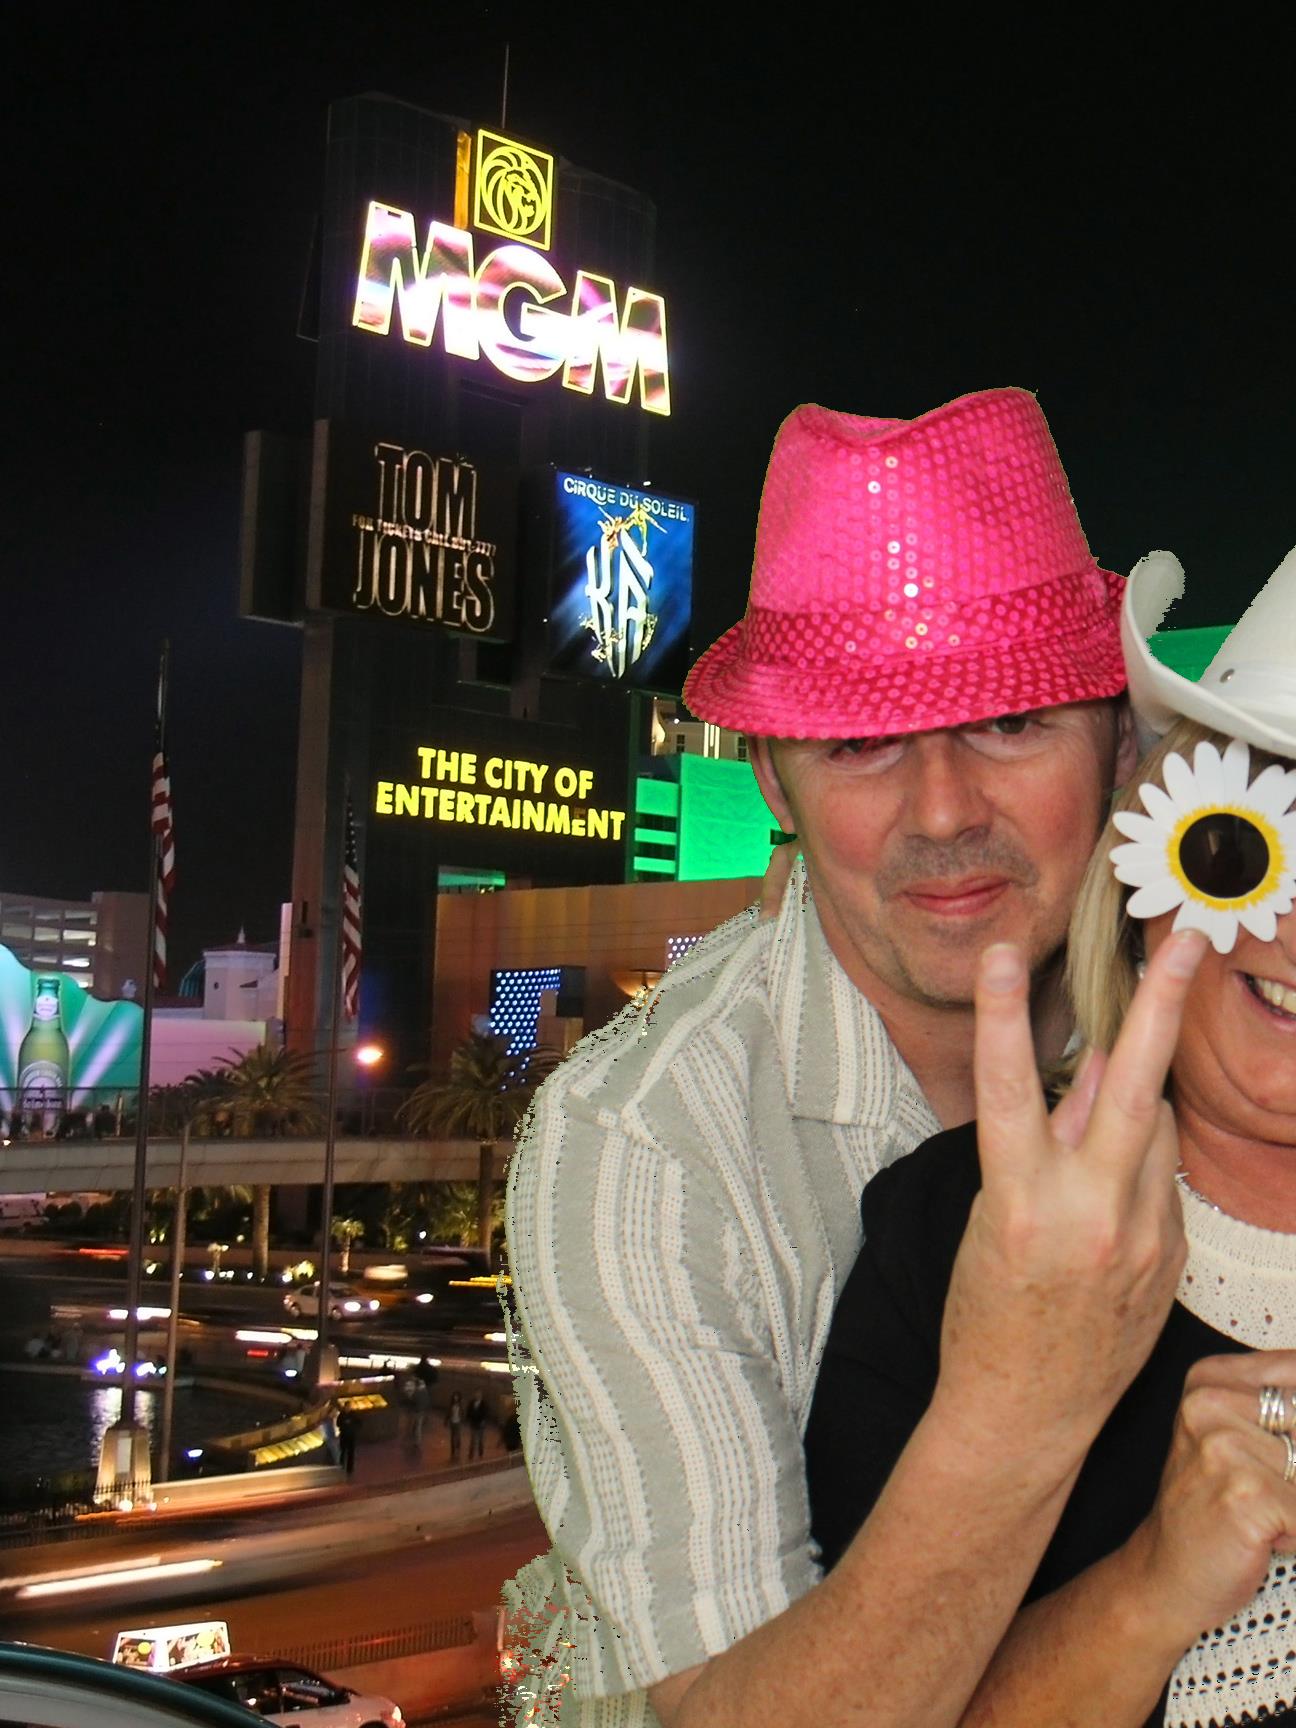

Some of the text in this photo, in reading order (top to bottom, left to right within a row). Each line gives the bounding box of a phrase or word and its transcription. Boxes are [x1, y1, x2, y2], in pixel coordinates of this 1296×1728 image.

[353, 200, 672, 416] MGM
[374, 442, 478, 540] TOM
[563, 477, 688, 522] CIRQUE DU SOLEIL
[352, 531, 495, 633] JONES
[376, 781, 626, 841] ENTERTAINMENT
[418, 746, 594, 800] THE CITY OF
